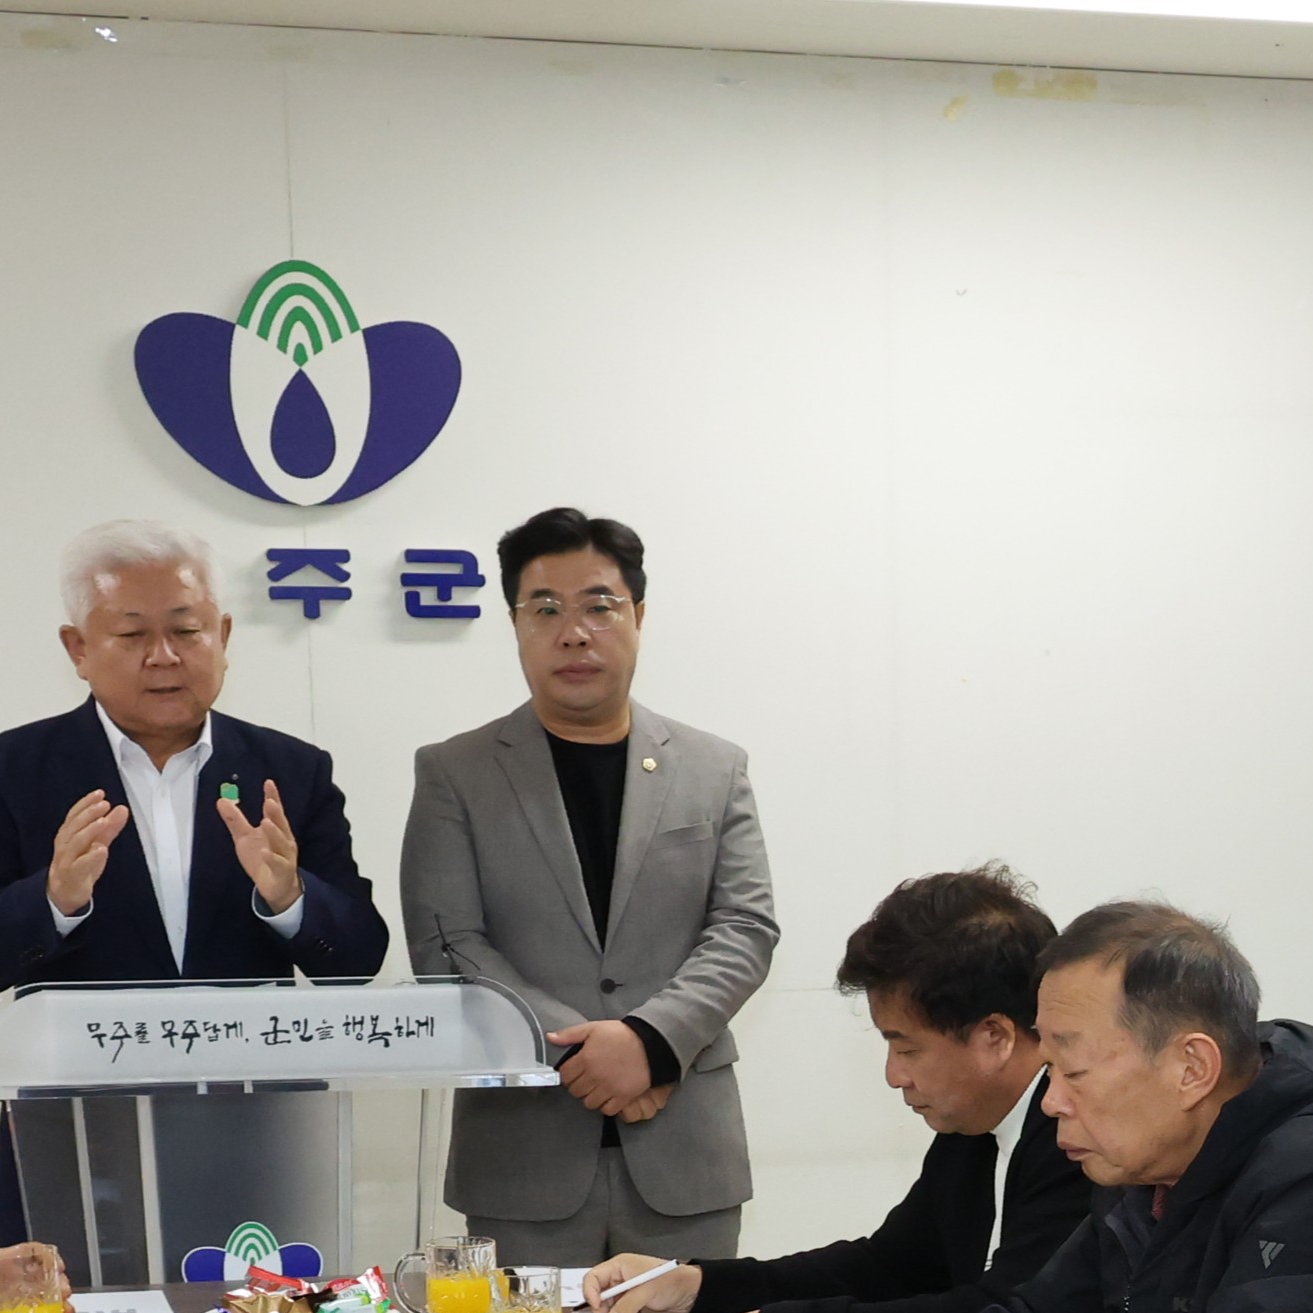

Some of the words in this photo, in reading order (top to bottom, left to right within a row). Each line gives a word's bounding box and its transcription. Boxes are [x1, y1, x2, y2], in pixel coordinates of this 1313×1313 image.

[87, 1020, 151, 1064] 무주를
[260, 1015, 334, 1045] 군민을
[342, 1014, 435, 1048] 행복하게
